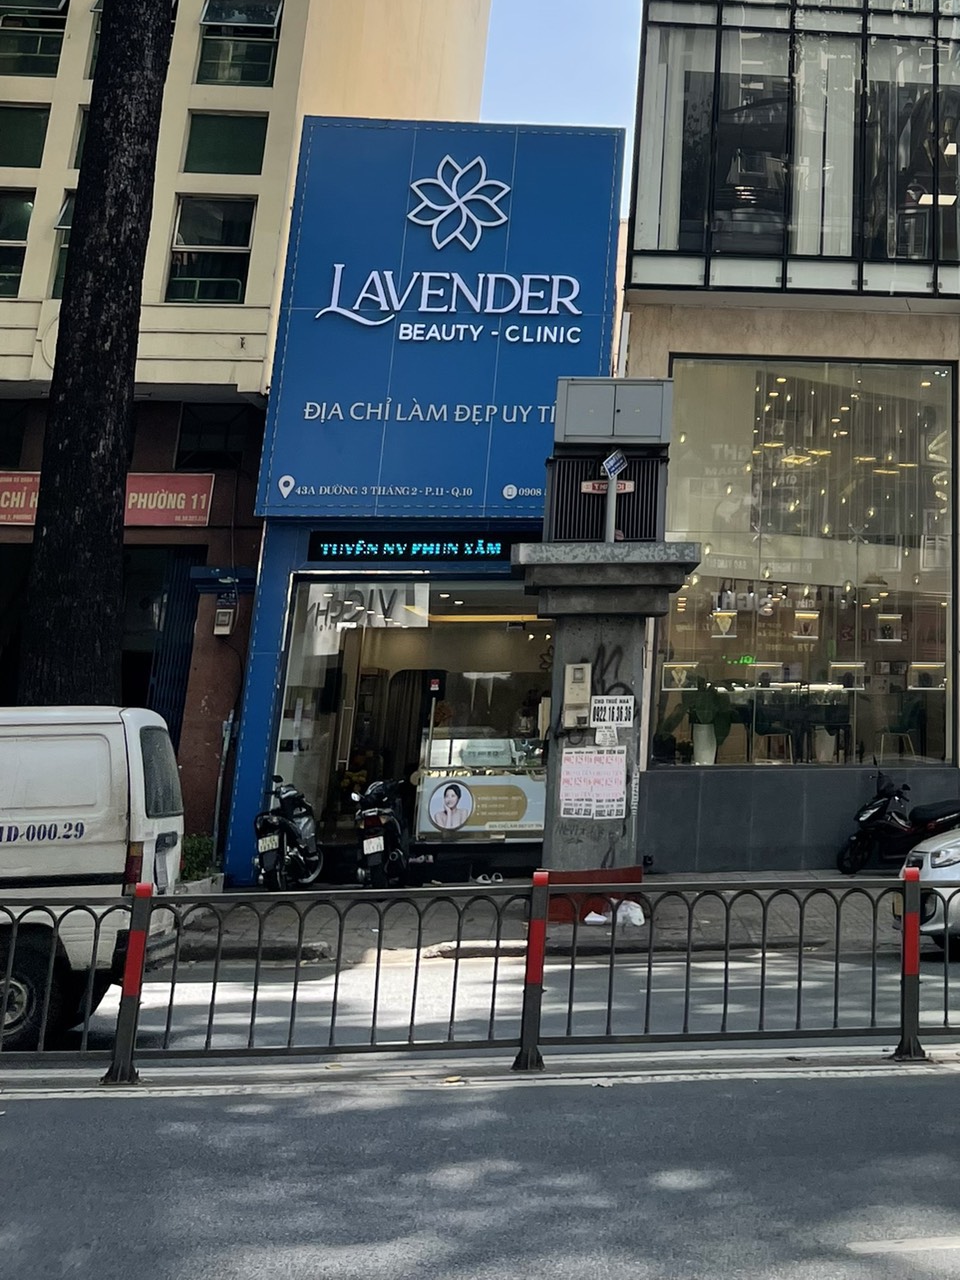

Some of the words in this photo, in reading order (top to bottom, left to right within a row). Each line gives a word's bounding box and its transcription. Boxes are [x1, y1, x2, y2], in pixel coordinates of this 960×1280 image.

[314, 263, 583, 326] LAVENDER
[399, 323, 484, 341] BEAUTY
[505, 325, 582, 344] CLINIC
[304, 401, 345, 423] ĐỊA
[350, 397, 392, 421] CHỈ
[396, 398, 448, 422] LÀM
[454, 404, 498, 425] ĐẸP
[502, 405, 533, 423] UY
[128, 488, 186, 510] PHƯỜNG
[191, 493, 207, 510] 11
[295, 486, 316, 495] 43A
[319, 484, 358, 495] ĐƯỜNG
[361, 486, 368, 495] 3
[370, 484, 410, 496] THÁNG
[411, 487, 418, 495] 2
[451, 487, 473, 498] Q.10
[518, 487, 542, 496] 0908
